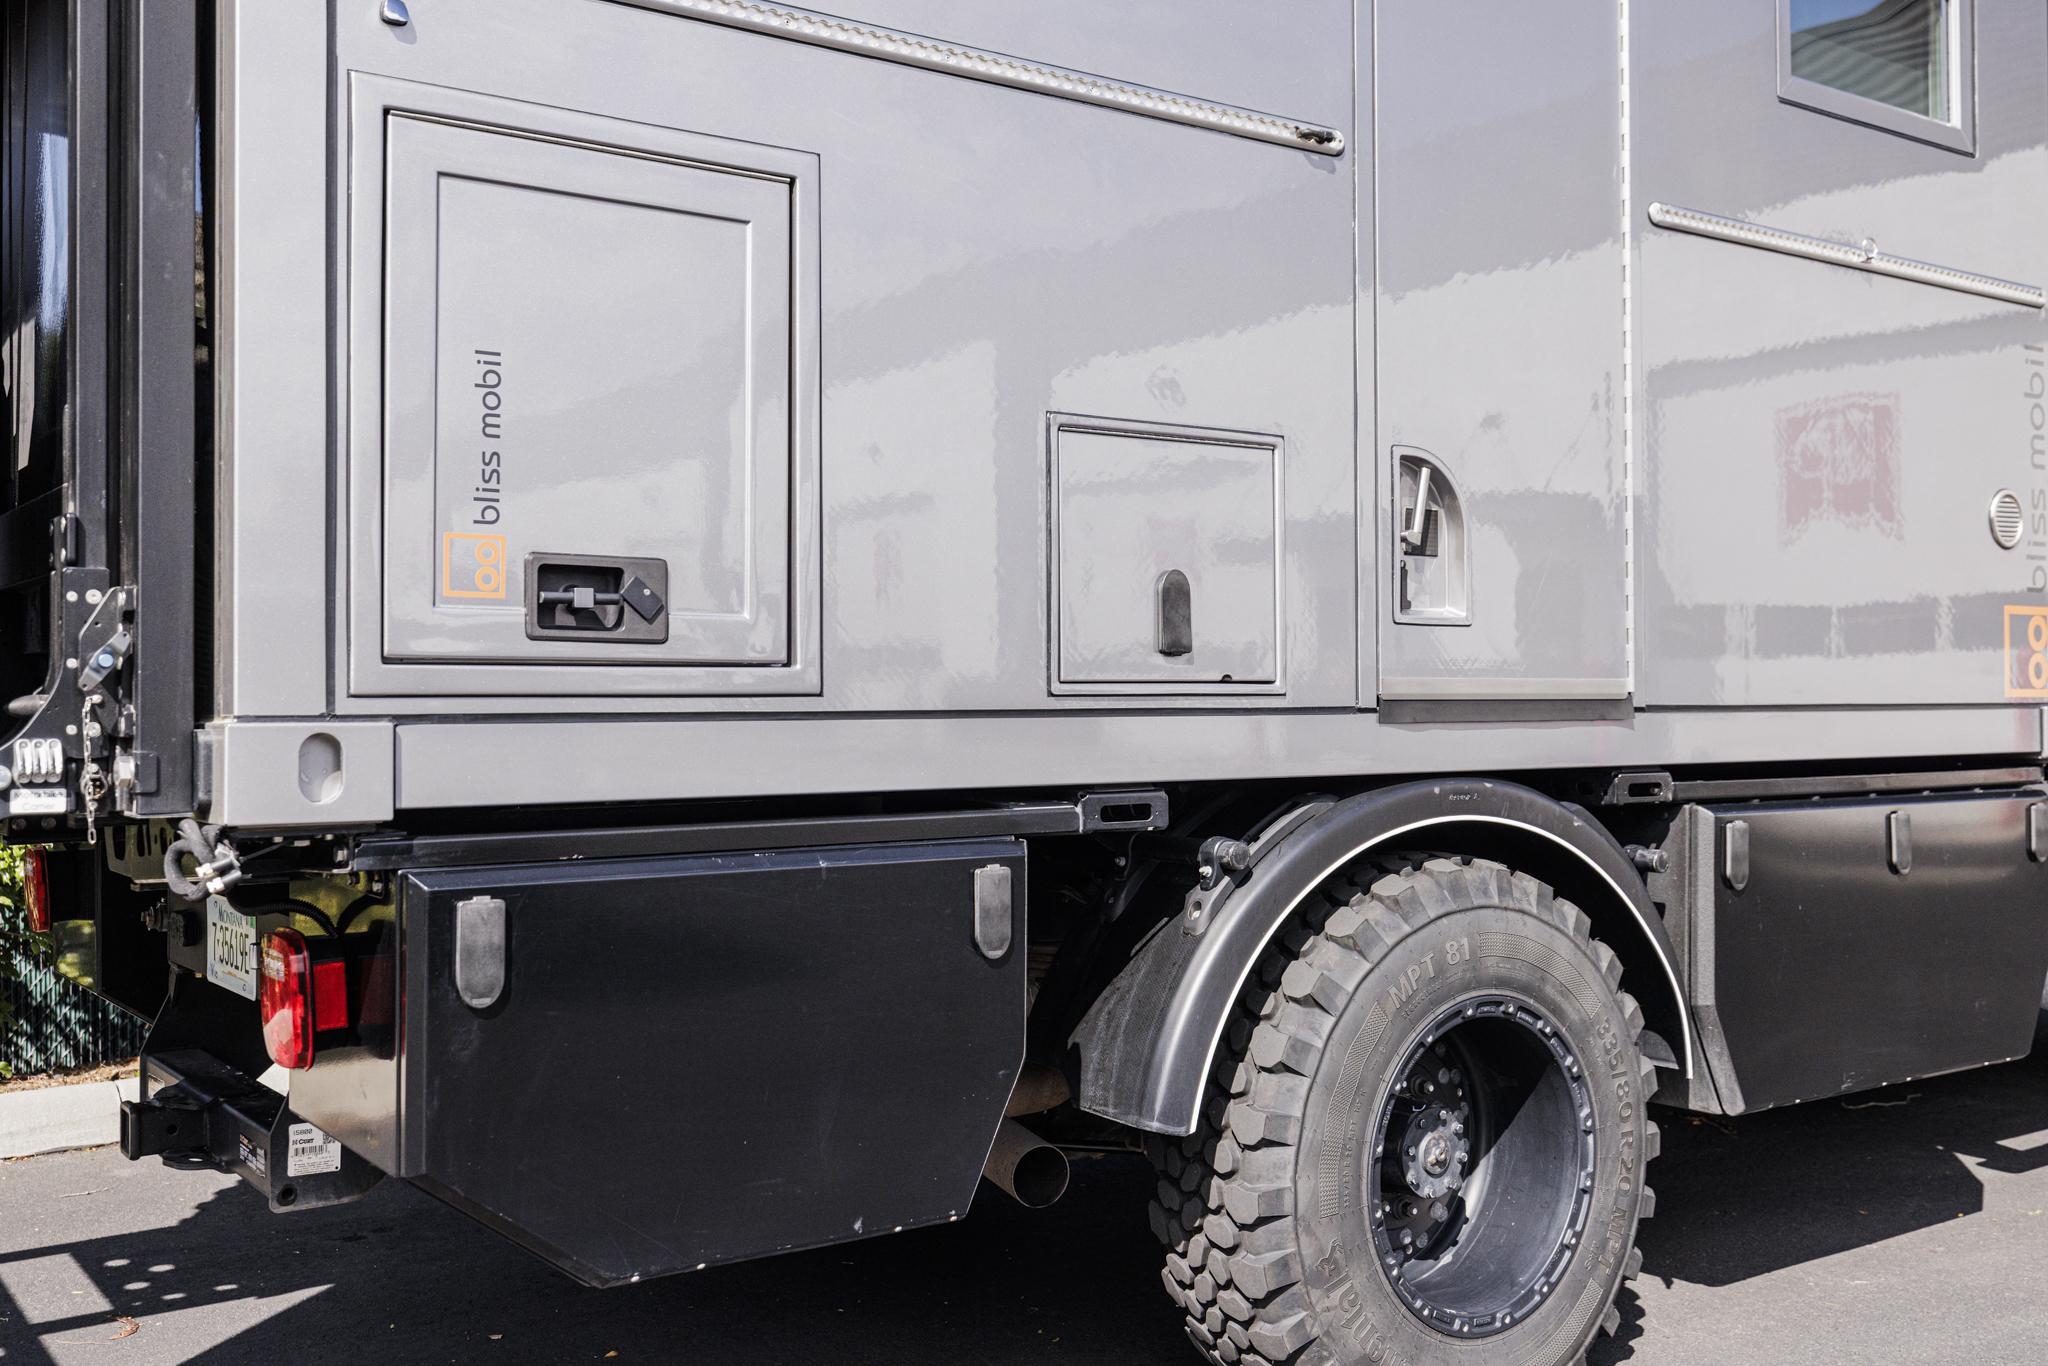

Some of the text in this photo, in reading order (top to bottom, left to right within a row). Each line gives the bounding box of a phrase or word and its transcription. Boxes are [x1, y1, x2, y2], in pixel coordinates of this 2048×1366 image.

[473, 349, 502, 525] bliss mobil
[2023, 344, 2048, 593] bliss mobil
[1386, 951, 1436, 1010] MPT
[1445, 937, 1470, 965] 81
[1598, 1206, 1627, 1275] MPT
